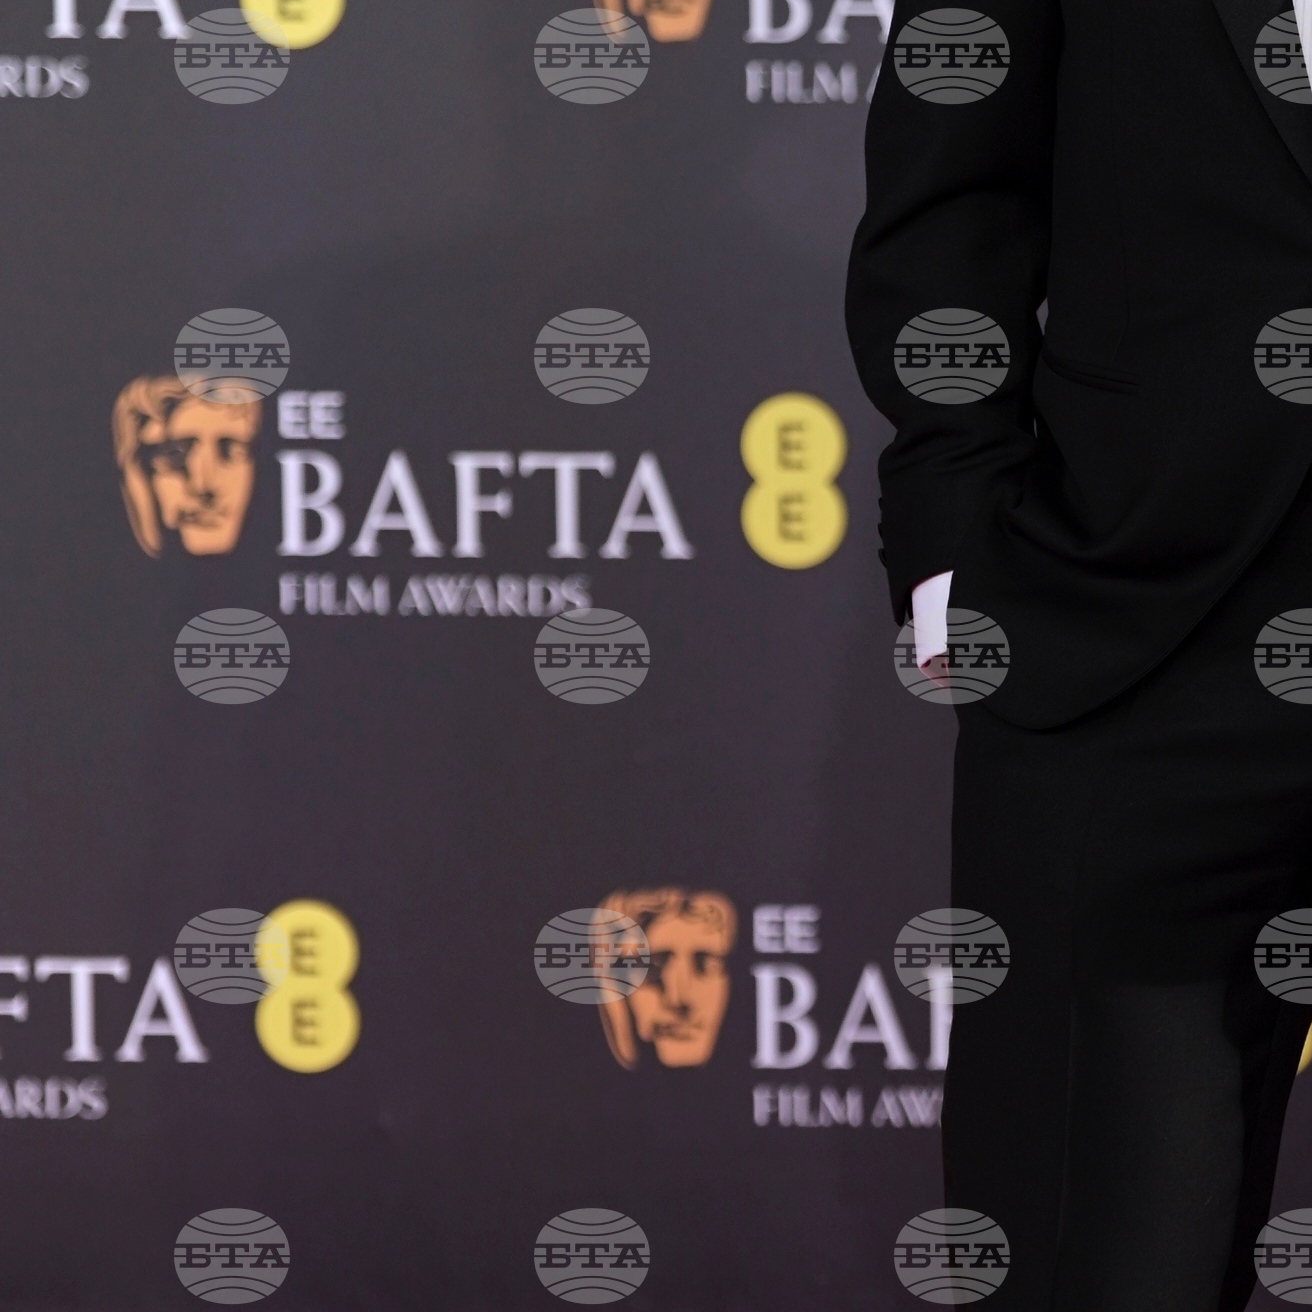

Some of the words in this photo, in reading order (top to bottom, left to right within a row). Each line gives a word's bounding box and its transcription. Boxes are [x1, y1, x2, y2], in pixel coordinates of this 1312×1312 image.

[745, 59, 858, 104] FILM
[277, 390, 346, 440] EE
[276, 449, 696, 559] BAFTA
[278, 570, 390, 616] FILM
[398, 573, 592, 617] AWARDS
[753, 904, 821, 954] EE
[752, 1083, 864, 1128] FILM
